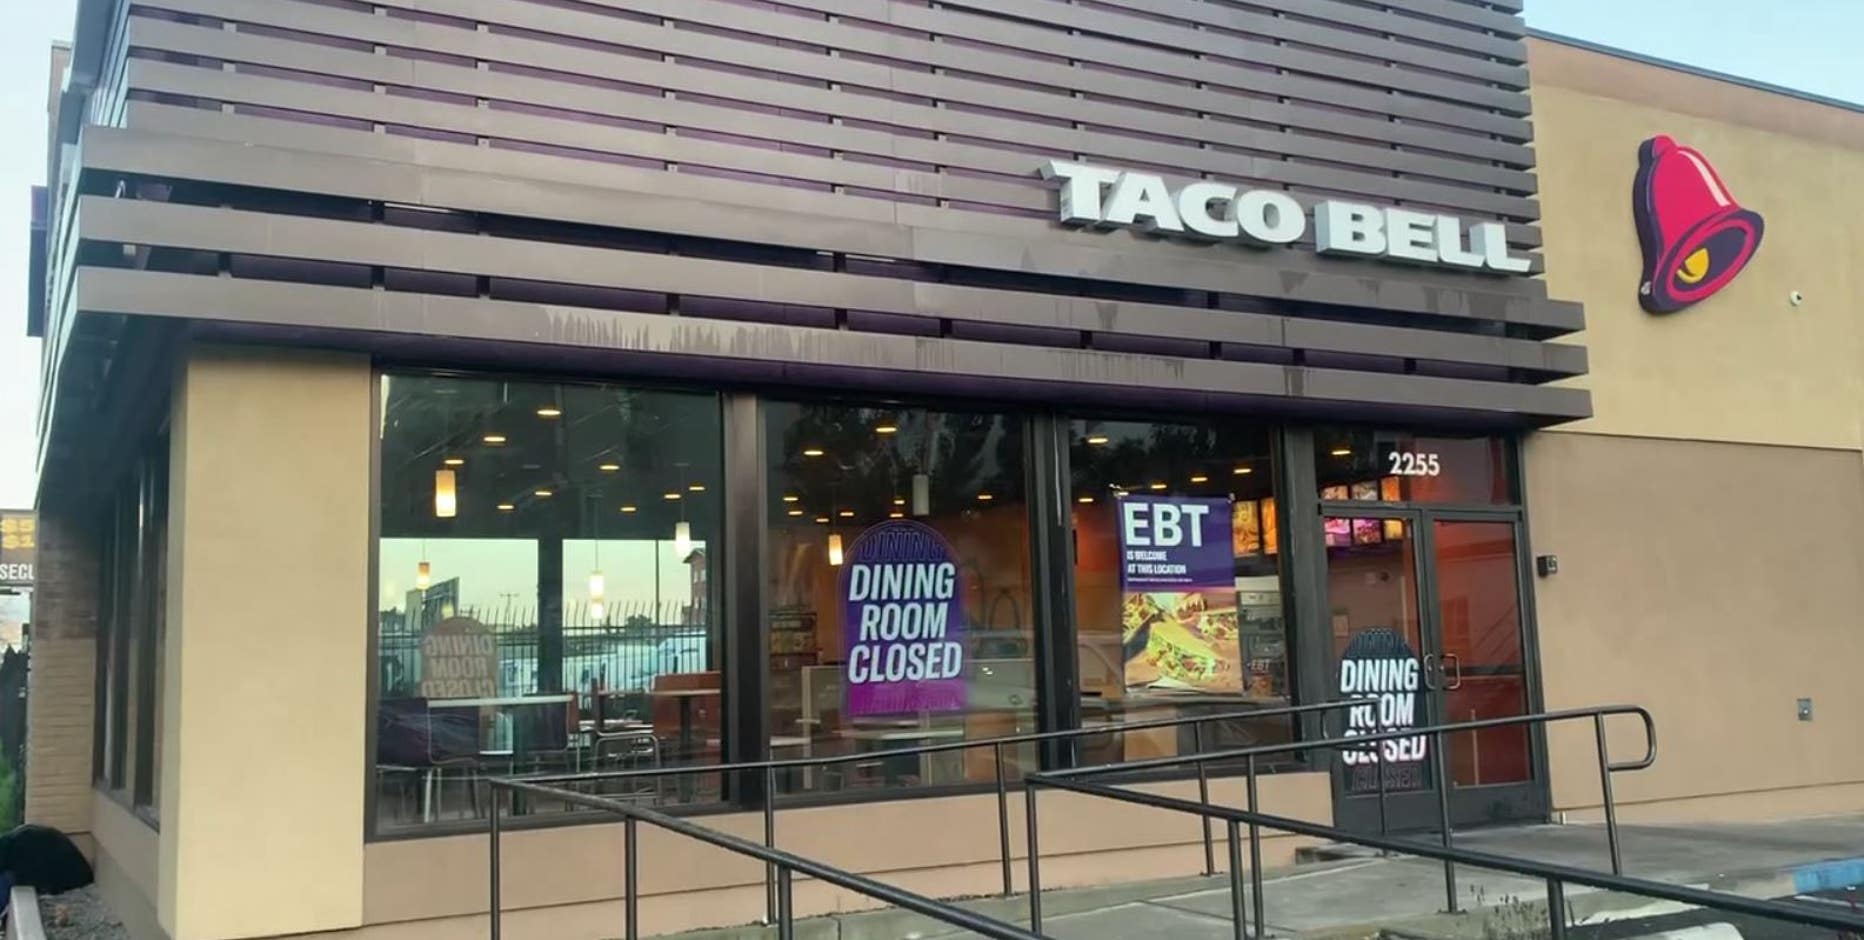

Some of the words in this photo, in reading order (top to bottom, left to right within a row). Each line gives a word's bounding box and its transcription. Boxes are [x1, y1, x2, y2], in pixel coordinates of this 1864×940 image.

[1040, 160, 1306, 244] TACO
[1315, 200, 1532, 273] BELL
[1389, 451, 1440, 476] 2255
[1123, 502, 1209, 547] EBT
[1126, 551, 1134, 561] IS
[1135, 551, 1167, 561] WELCOME
[1127, 564, 1136, 574] AT
[1137, 564, 1153, 574] THIS
[1154, 564, 1187, 574] LOCATION
[849, 562, 955, 601] DINING
[860, 602, 948, 641] ROOM
[848, 642, 962, 684] CLOSED
[1340, 658, 1419, 693] DINING
